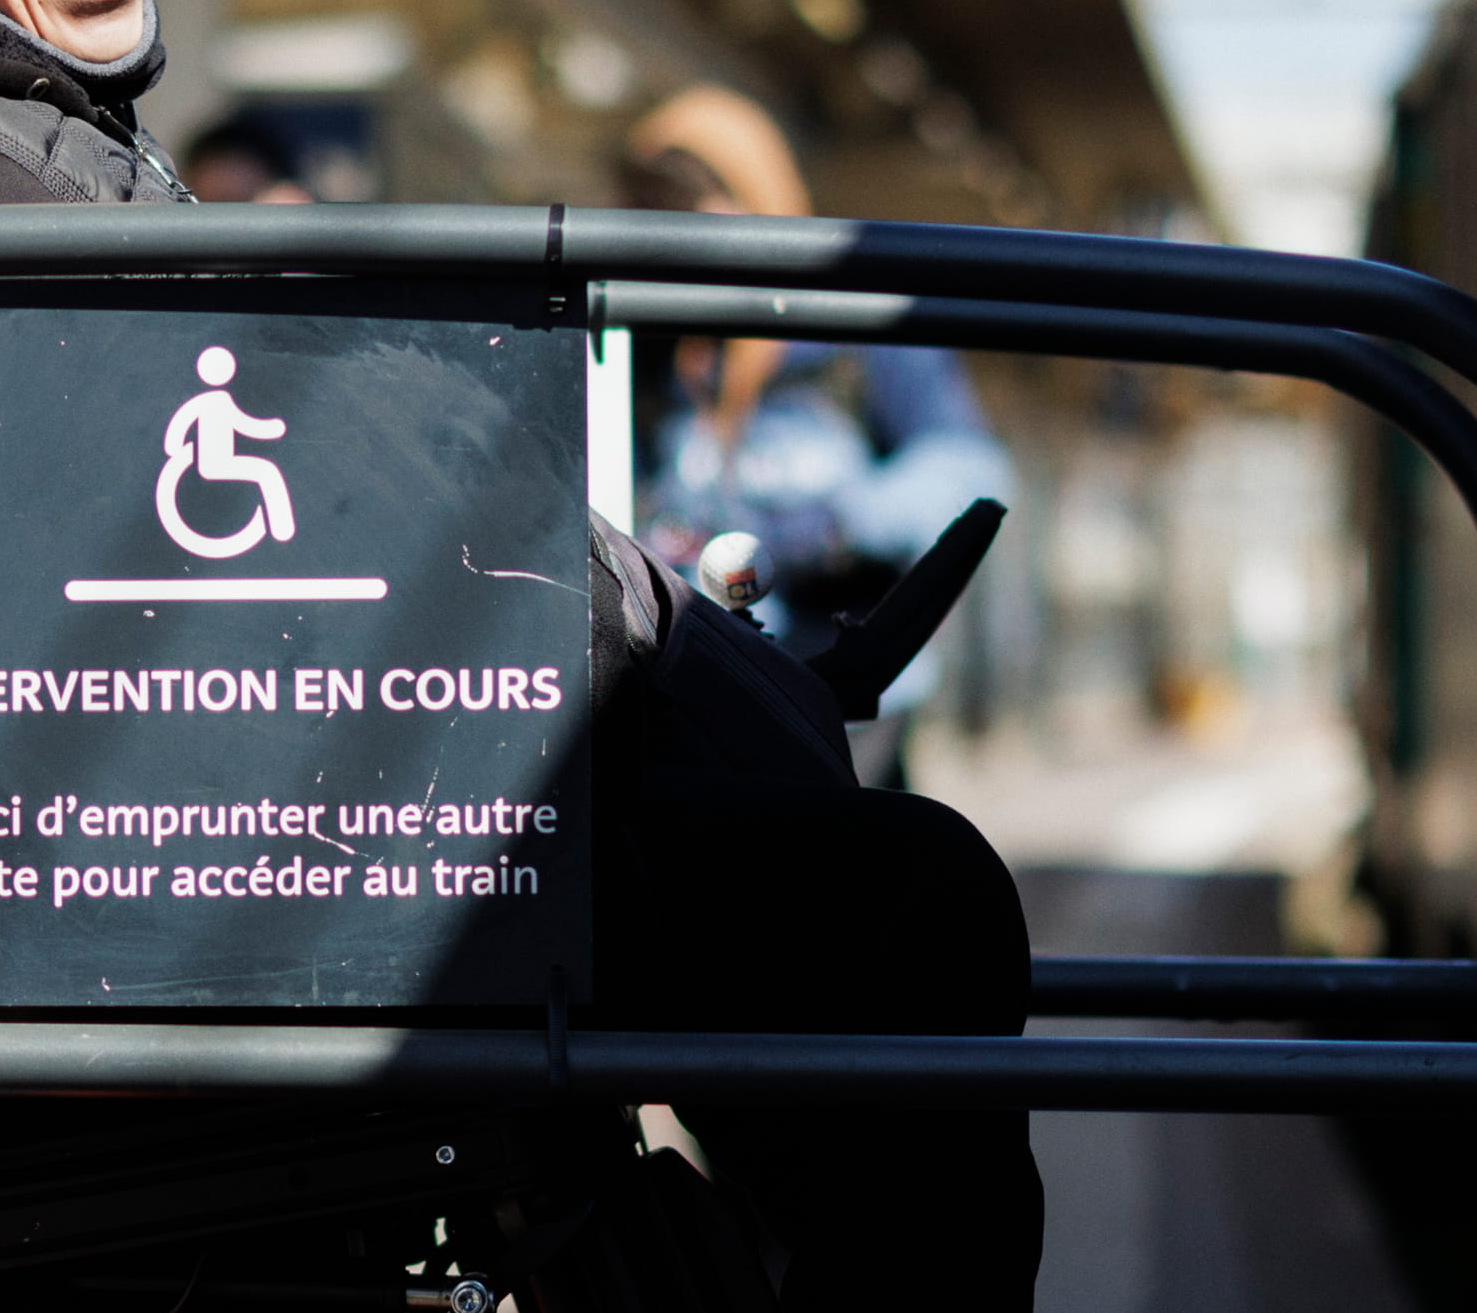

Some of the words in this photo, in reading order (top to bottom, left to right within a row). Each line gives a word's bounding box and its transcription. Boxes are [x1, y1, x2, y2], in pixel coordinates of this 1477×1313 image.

[294, 669, 364, 711] EN
[379, 667, 562, 711] COURS
[339, 804, 423, 836] une
[436, 797, 558, 836] autre
[52, 865, 159, 908] pour
[171, 855, 352, 897] accéder
[363, 865, 418, 896] au
[433, 855, 538, 896] train
